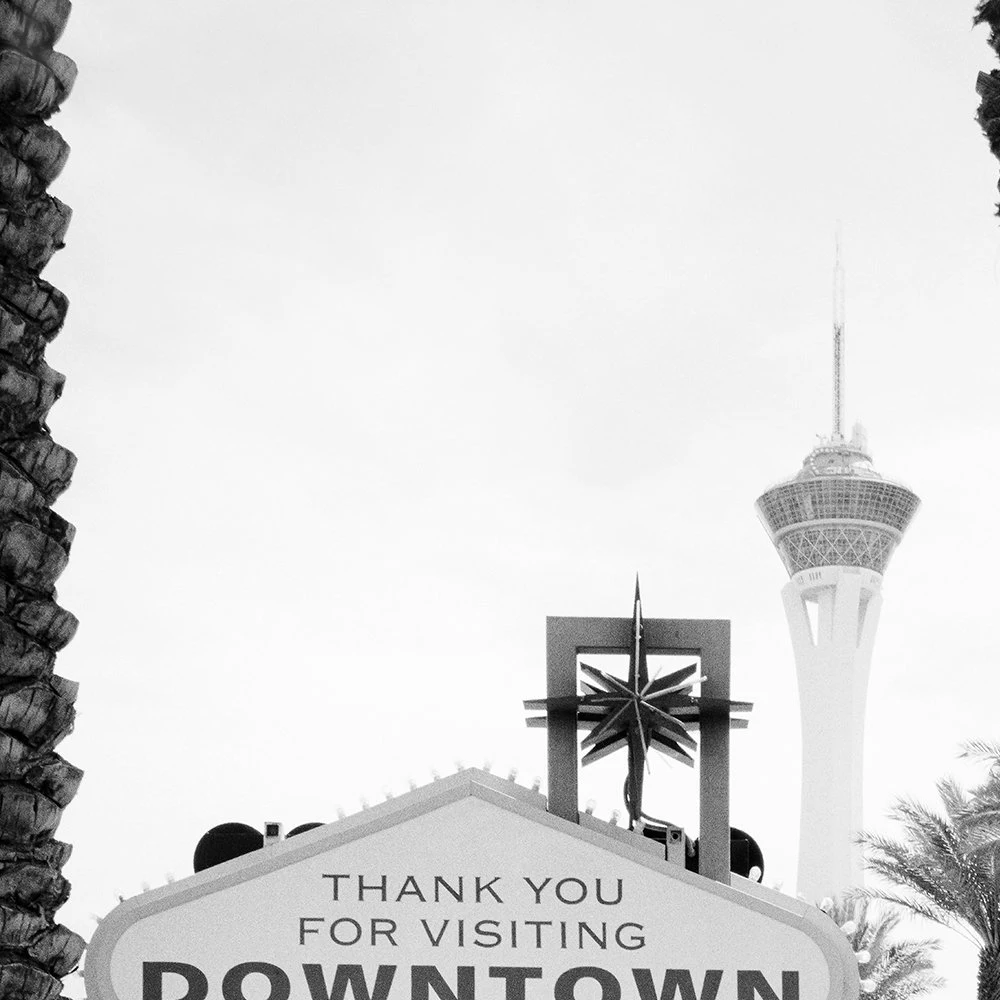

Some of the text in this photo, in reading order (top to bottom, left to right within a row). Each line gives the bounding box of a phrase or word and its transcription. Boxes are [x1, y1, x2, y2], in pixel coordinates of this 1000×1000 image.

[322, 874, 623, 906] THANK YOU
[299, 917, 646, 951] FOR VISITING
